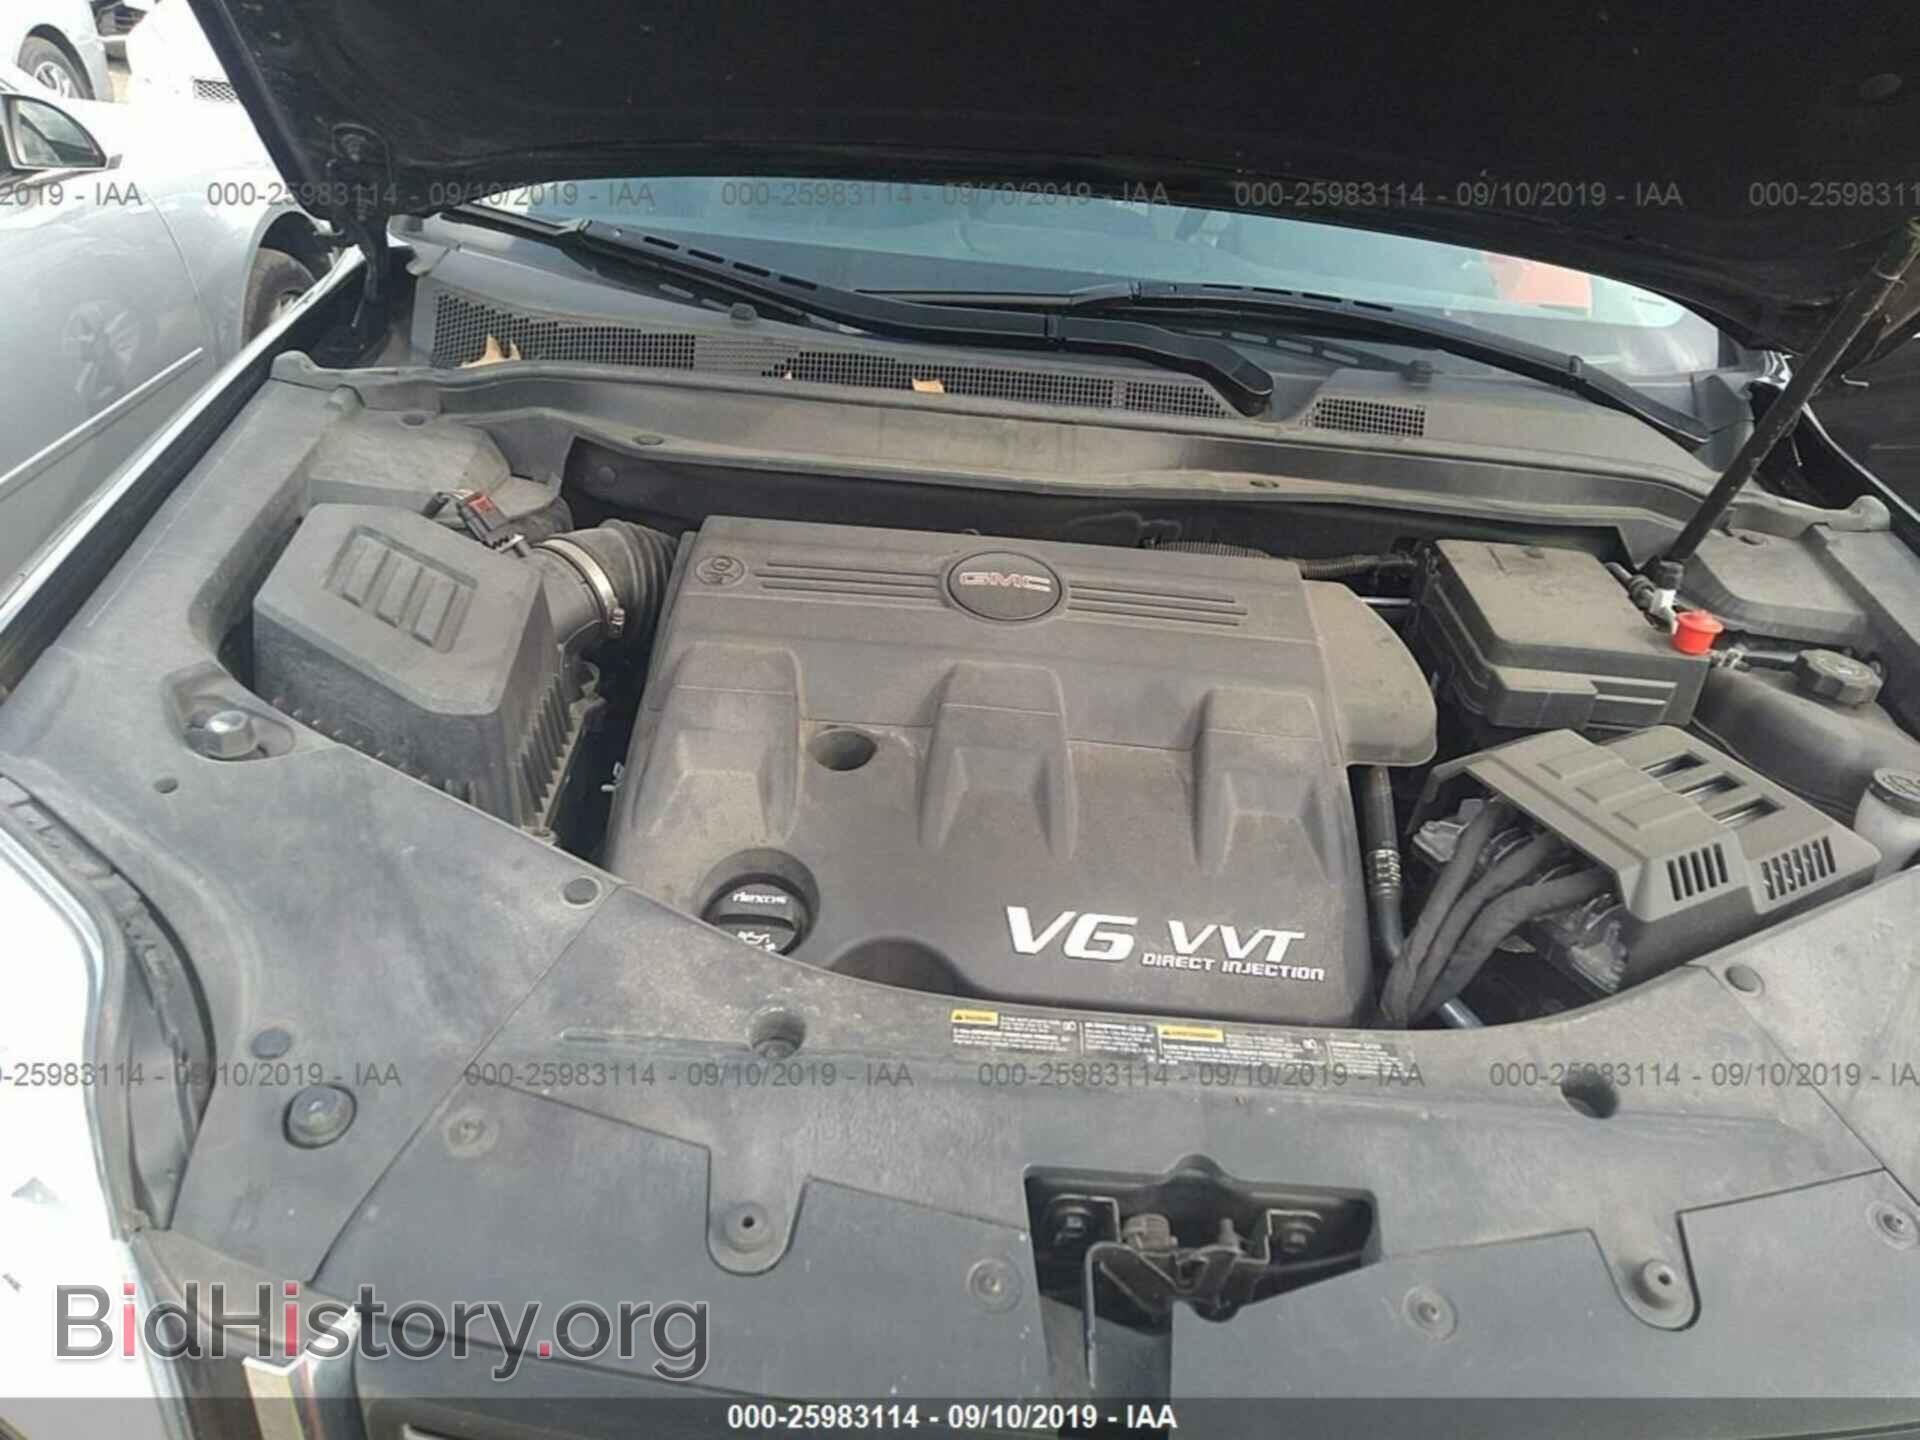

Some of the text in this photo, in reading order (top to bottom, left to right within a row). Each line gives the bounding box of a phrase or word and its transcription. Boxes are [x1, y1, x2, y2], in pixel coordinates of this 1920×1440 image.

[960, 572, 1051, 592] GMC
[1006, 905, 1305, 963] V6 VVT
[1142, 952, 1325, 982] DIRECT INJECTION
